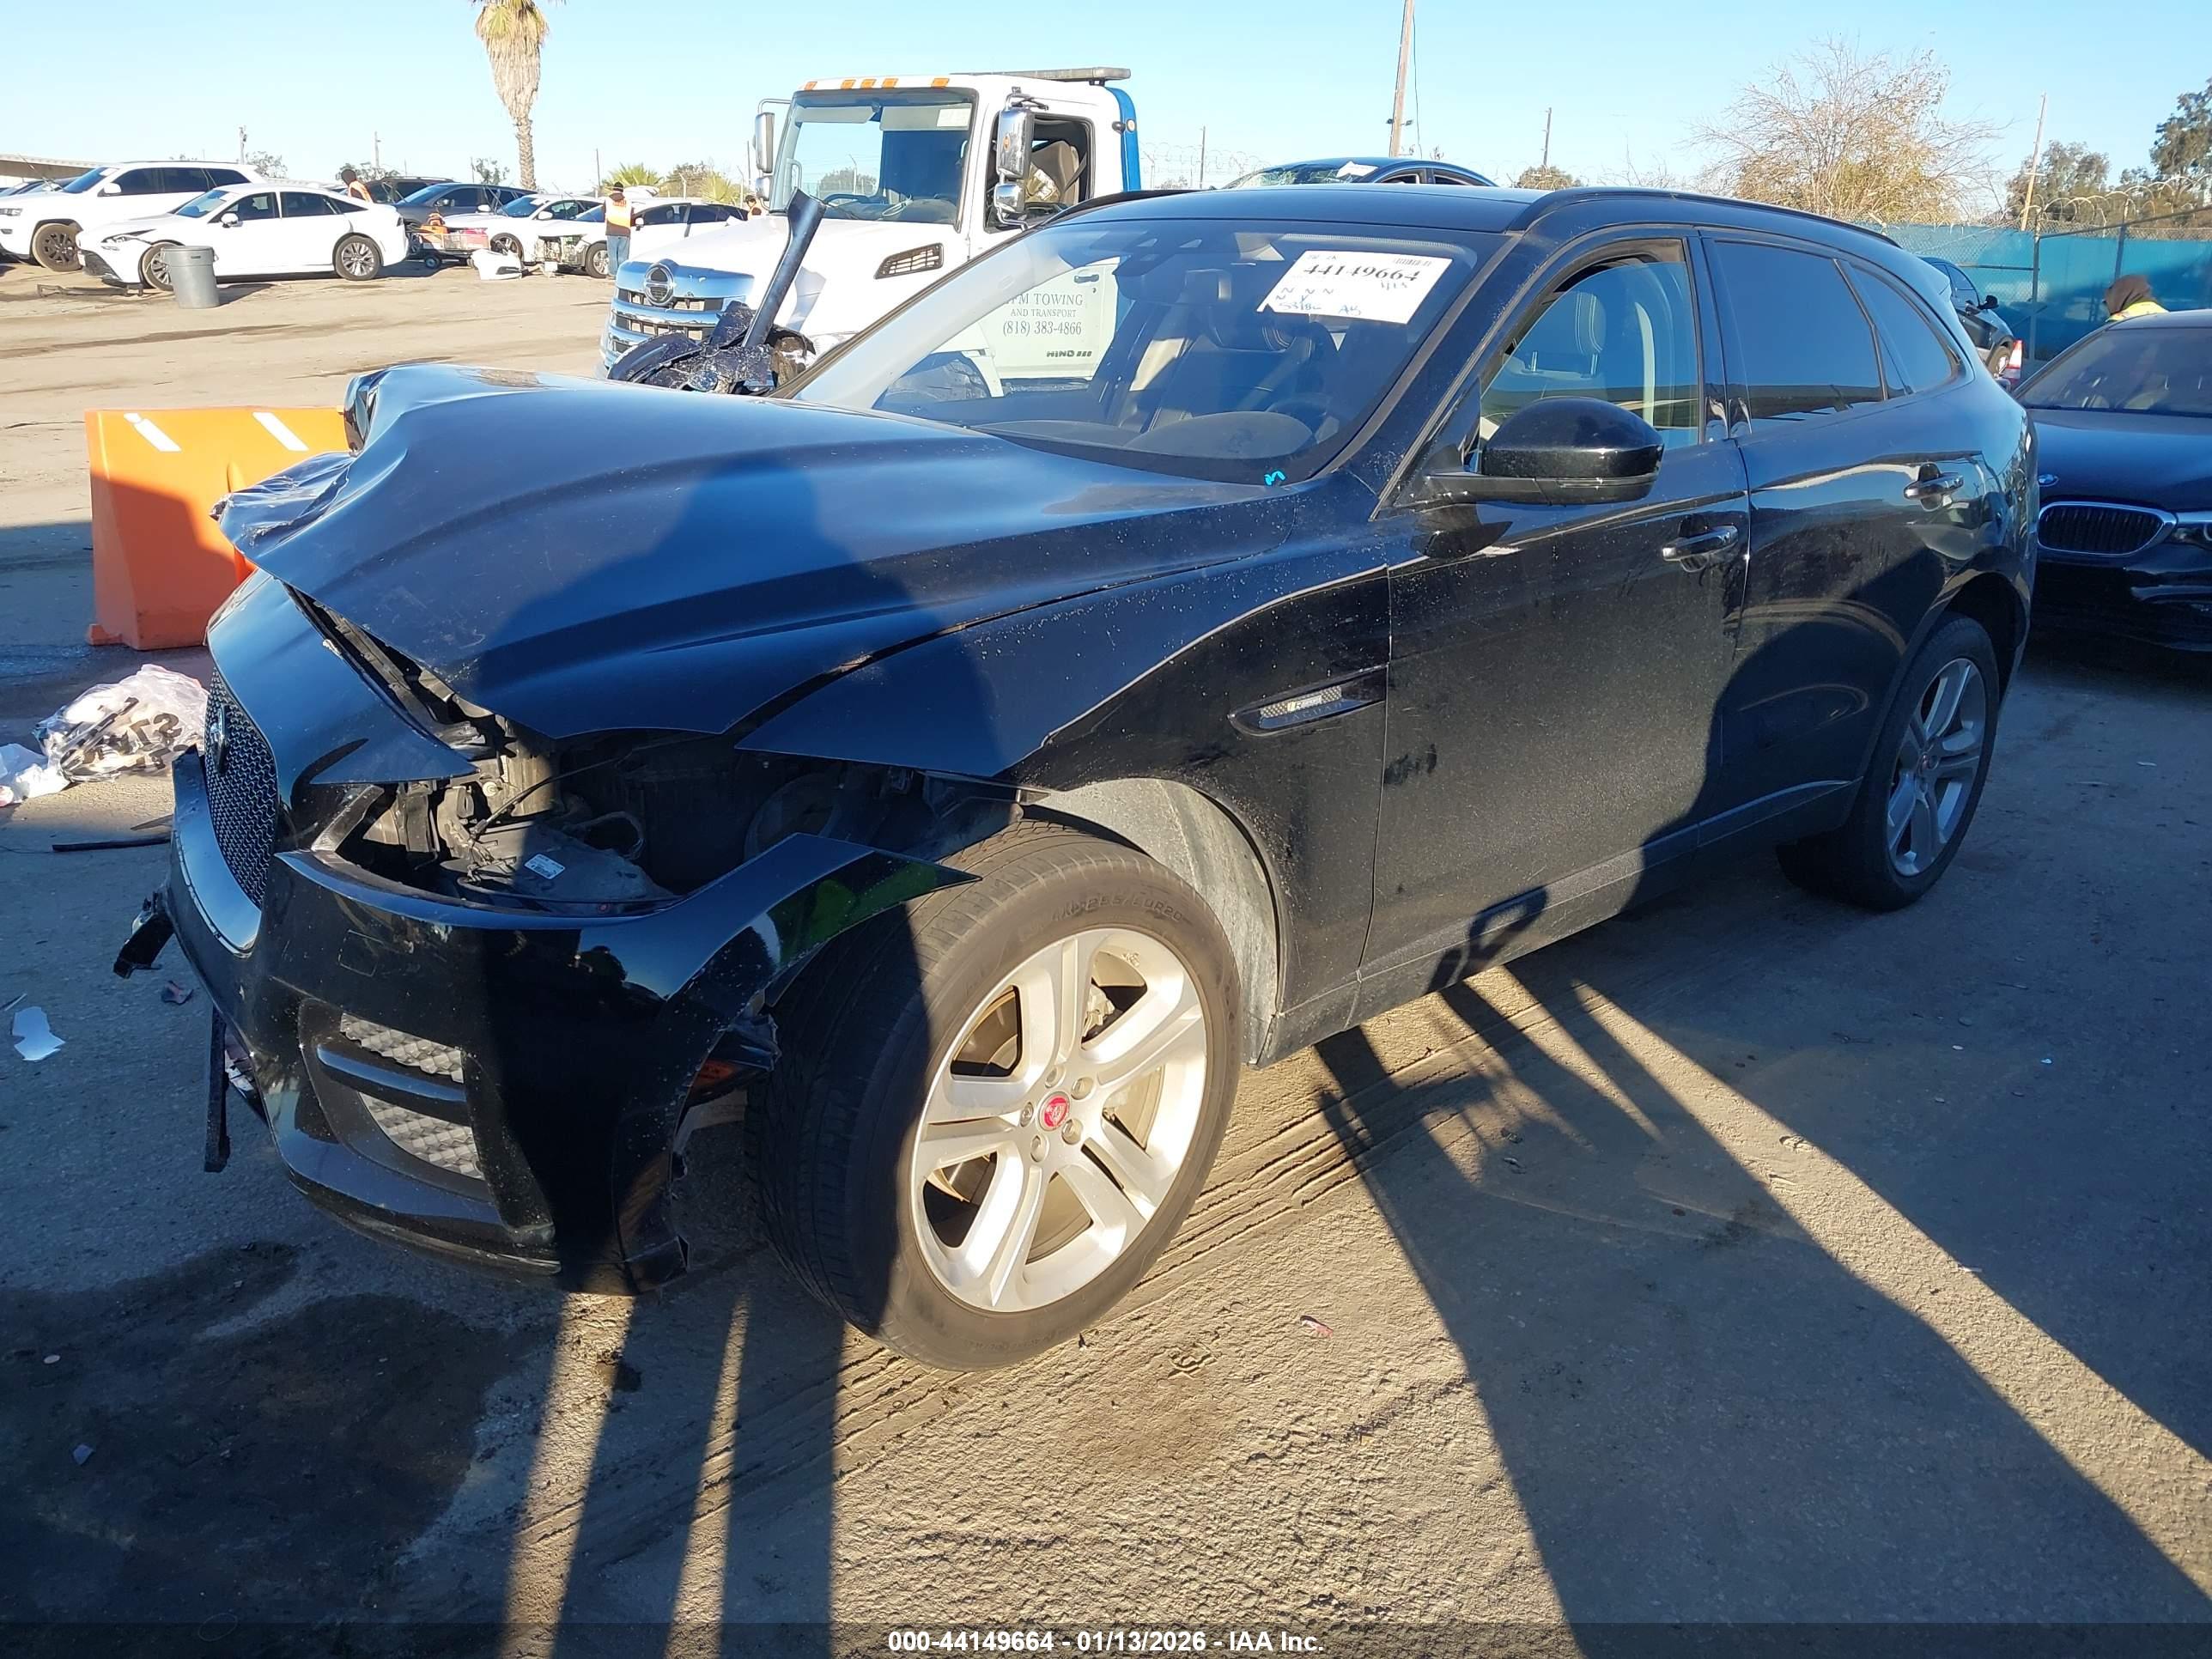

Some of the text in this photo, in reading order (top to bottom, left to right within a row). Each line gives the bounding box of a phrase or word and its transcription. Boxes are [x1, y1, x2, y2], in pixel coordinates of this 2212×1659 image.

[1304, 263, 1421, 281] 44149664
[1034, 293, 1084, 306] TOWING
[1011, 308, 1077, 318] AND TRANSPORT
[1003, 320, 1082, 337] (818) 383-4866
